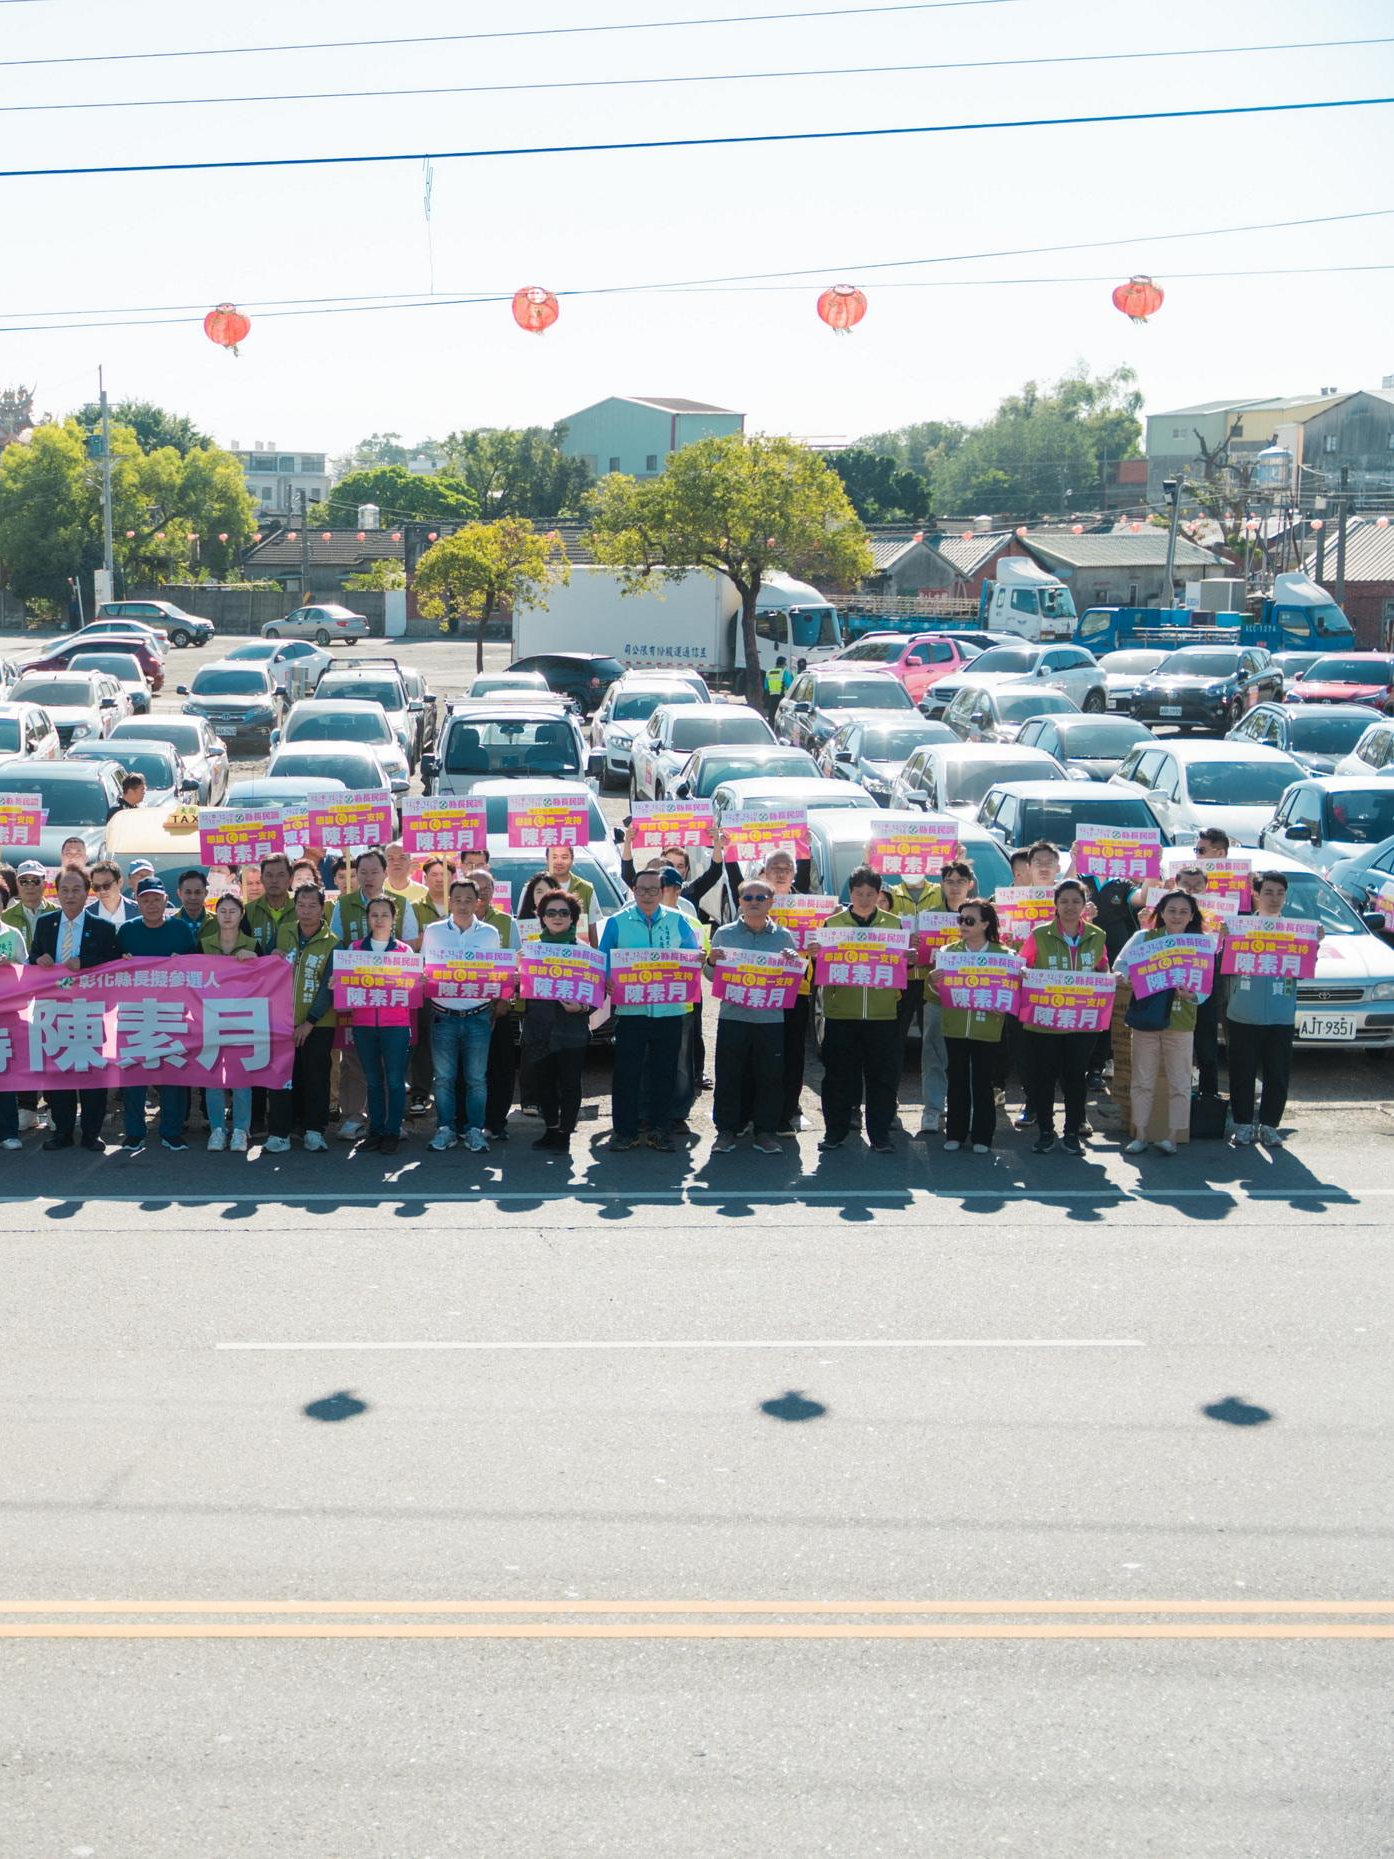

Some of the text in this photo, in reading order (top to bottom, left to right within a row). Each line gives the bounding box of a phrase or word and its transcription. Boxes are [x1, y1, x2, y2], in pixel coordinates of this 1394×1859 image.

[171, 815, 199, 823] TAX
[322, 824, 380, 844] 陳素月
[416, 830, 473, 850] 陳素月
[521, 827, 576, 844] 陳素月
[644, 829, 699, 846] 陳素月
[1088, 856, 1146, 876] 陳素月
[1234, 952, 1300, 974] 陳素月
[78, 968, 220, 989] 彰化縣長擬參選人
[829, 963, 893, 985] 陳素月
[346, 986, 408, 1007] 陳素月
[438, 980, 500, 997] 陳素月
[534, 977, 593, 1002] 陳素月
[624, 982, 686, 1001] 陳素月
[724, 984, 786, 1006] 陳素月
[950, 988, 1012, 1009] 陳素月
[1034, 1006, 1098, 1028] 陳素月
[26, 995, 272, 1072] 陳素月
